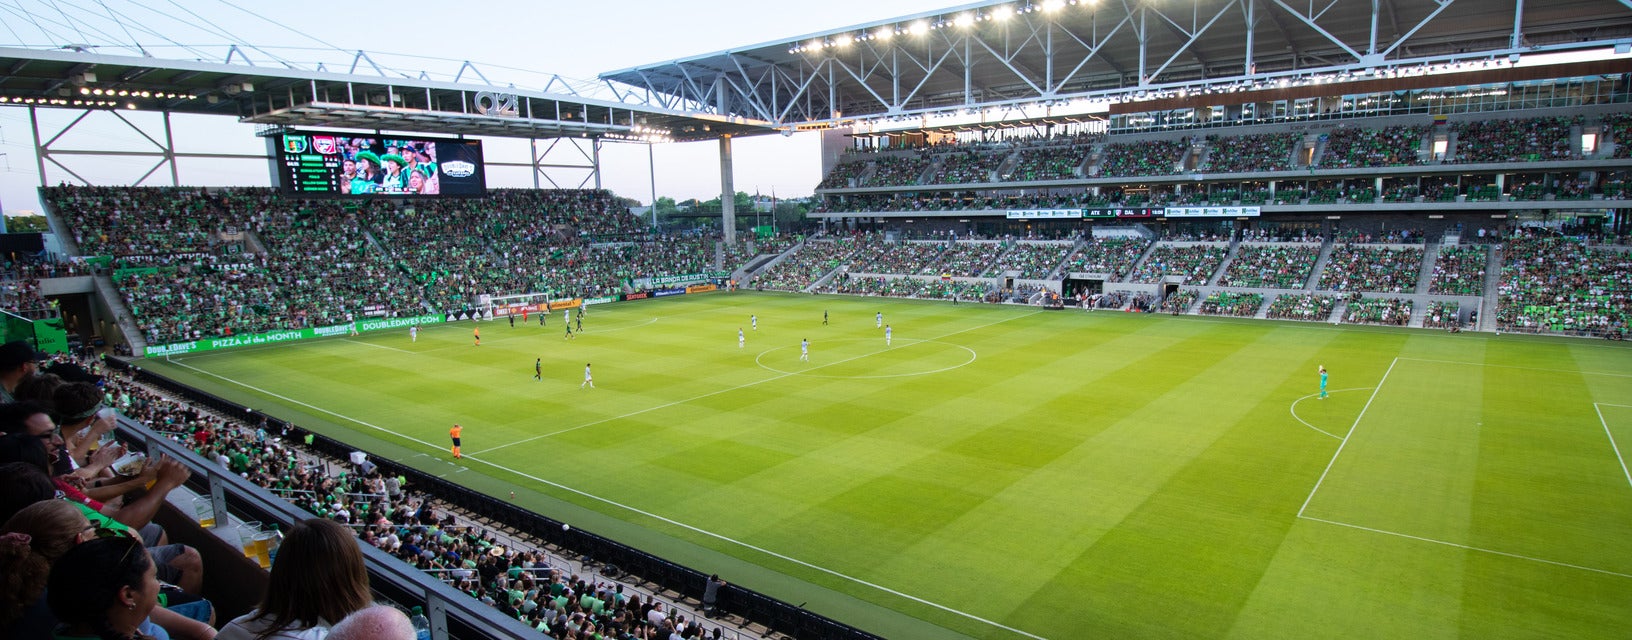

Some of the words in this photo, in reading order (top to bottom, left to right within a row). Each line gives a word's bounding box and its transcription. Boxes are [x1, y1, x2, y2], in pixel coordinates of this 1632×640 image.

[475, 91, 515, 116] Q2
[585, 297, 611, 305] Heineken
[363, 316, 440, 331] DOUBLEDAVES.COM
[37, 337, 56, 345] ulio
[212, 338, 241, 348] PIZZA
[253, 335, 265, 343] the
[266, 331, 302, 342] MONTH
